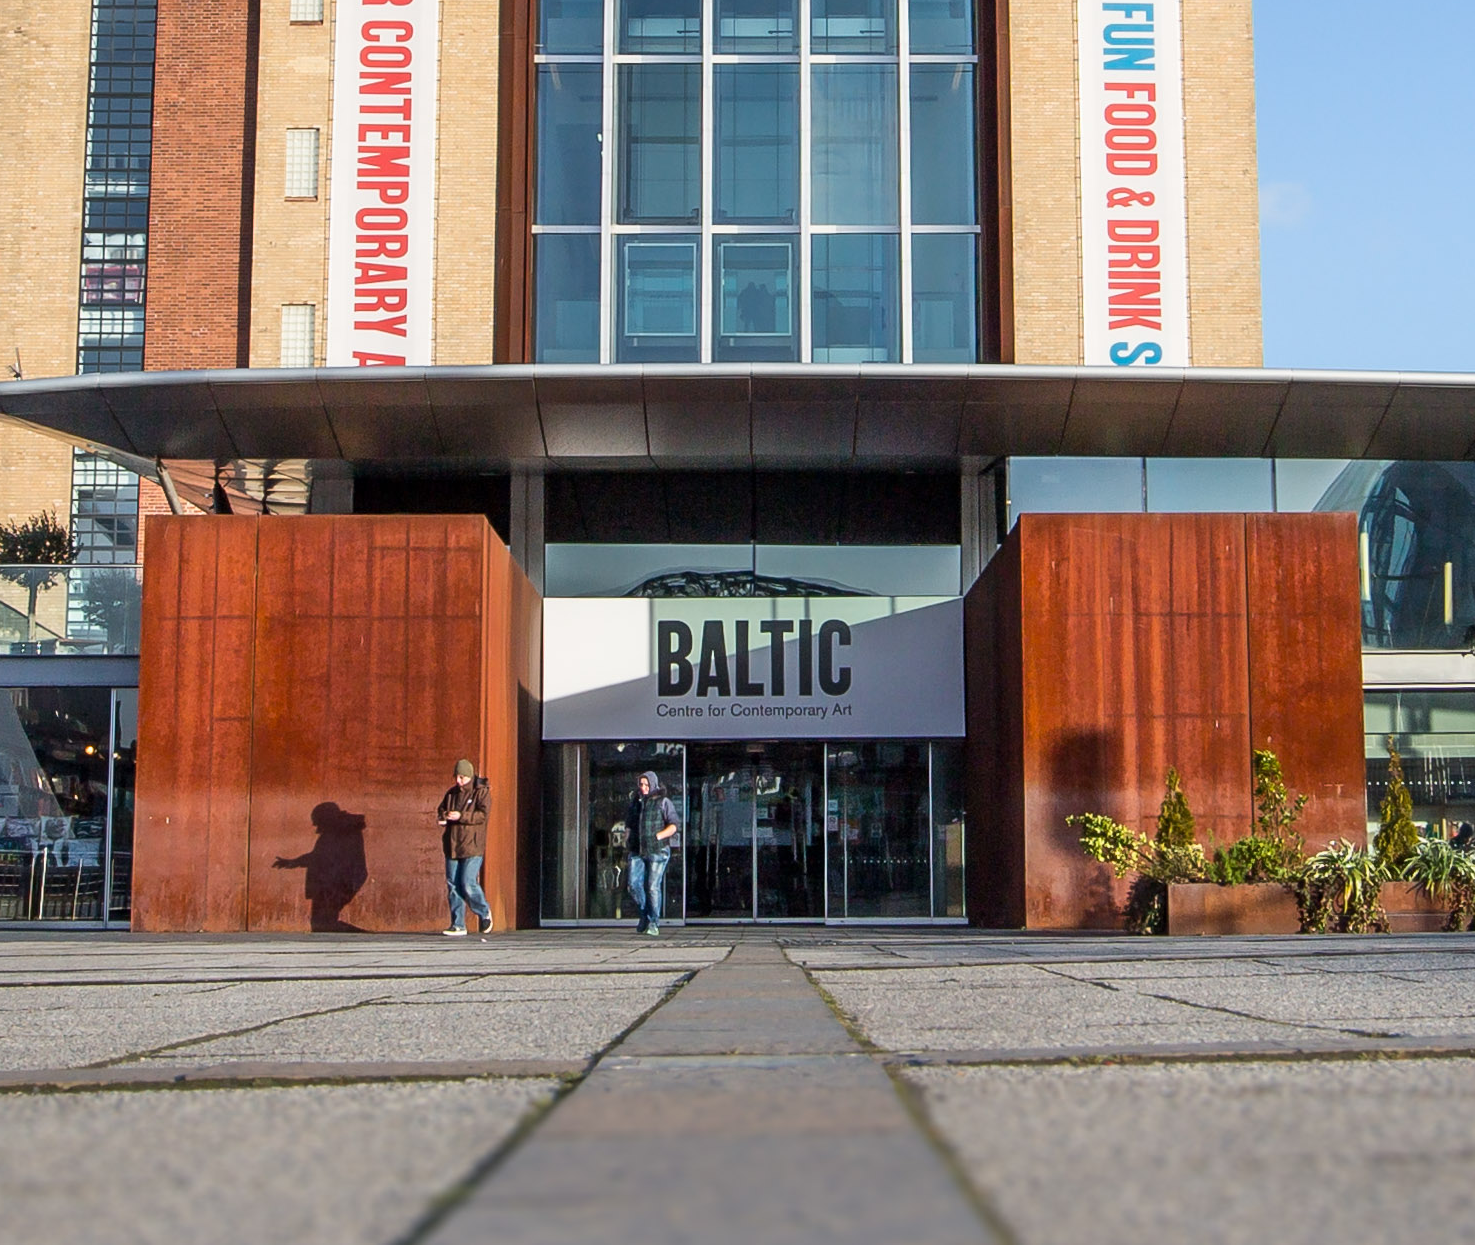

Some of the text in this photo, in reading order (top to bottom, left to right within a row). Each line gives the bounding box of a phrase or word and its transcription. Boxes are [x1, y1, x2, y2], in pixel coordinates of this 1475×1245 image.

[1102, 2, 1155, 71] FUN
[1104, 82, 1158, 177] FOOD
[353, 20, 414, 338] CONTEMPORARY
[1106, 187, 1156, 208] &
[1107, 219, 1162, 331] DRINK
[1109, 341, 1162, 367] S
[656, 619, 852, 697] BALTIC
[656, 703, 853, 720] Centre for Contemporary Art
